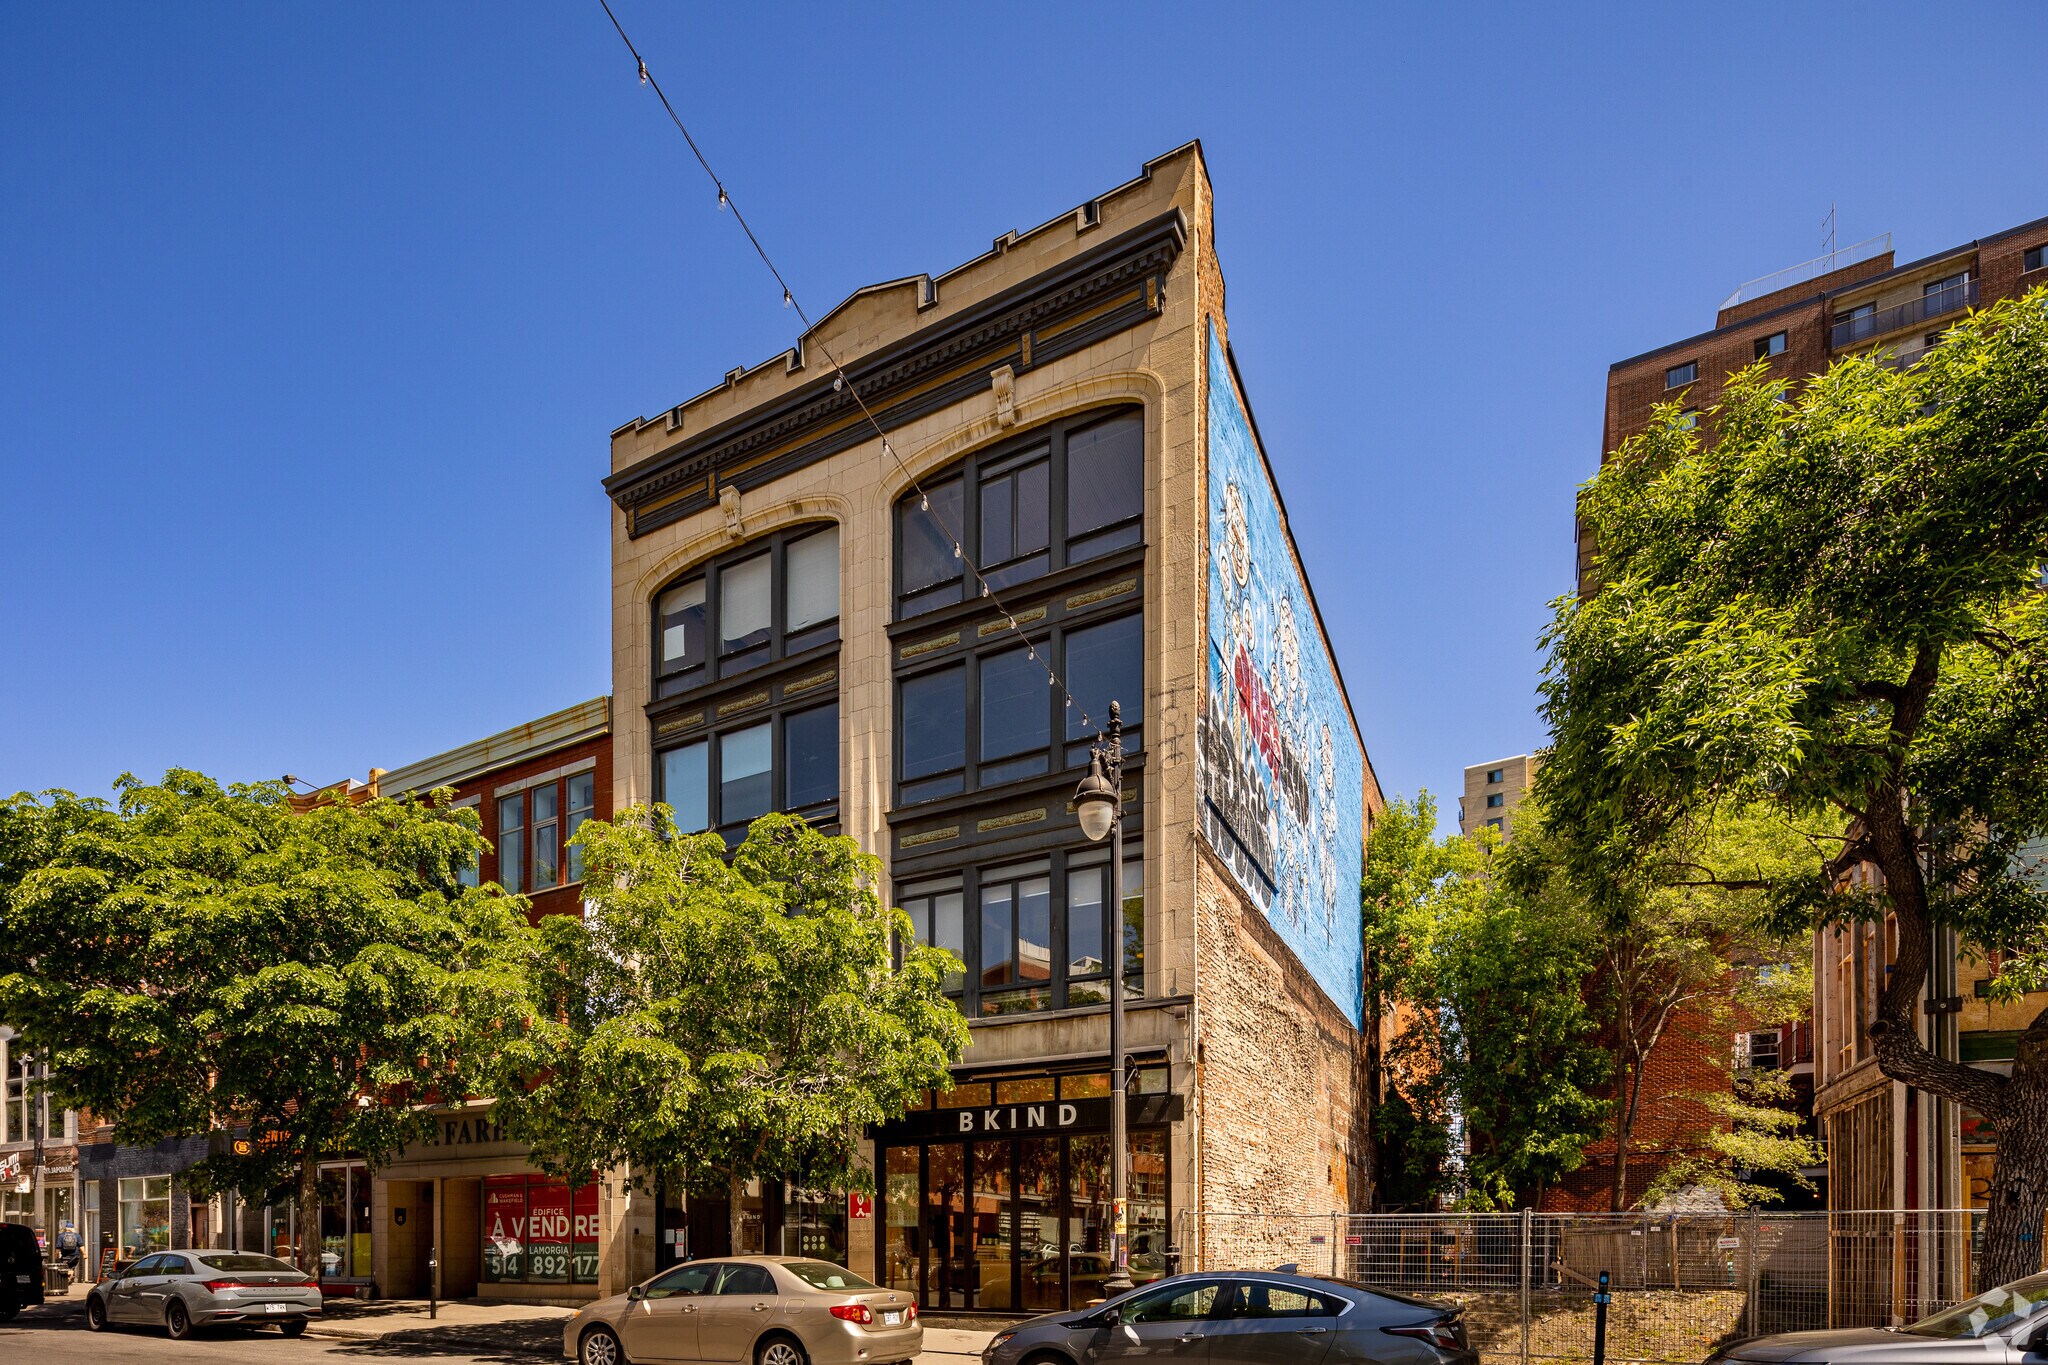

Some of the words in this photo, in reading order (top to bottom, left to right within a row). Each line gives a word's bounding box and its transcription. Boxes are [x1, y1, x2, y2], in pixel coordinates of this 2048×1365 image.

[960, 1104, 1077, 1132] BKIND
[533, 1207, 564, 1216] ÉDIFICE
[493, 1212, 506, 1237] À
[511, 1215, 599, 1238] VENDRE
[529, 1246, 569, 1255] LAMORGIA
[492, 1257, 518, 1275] 514
[533, 1256, 566, 1275] 892
